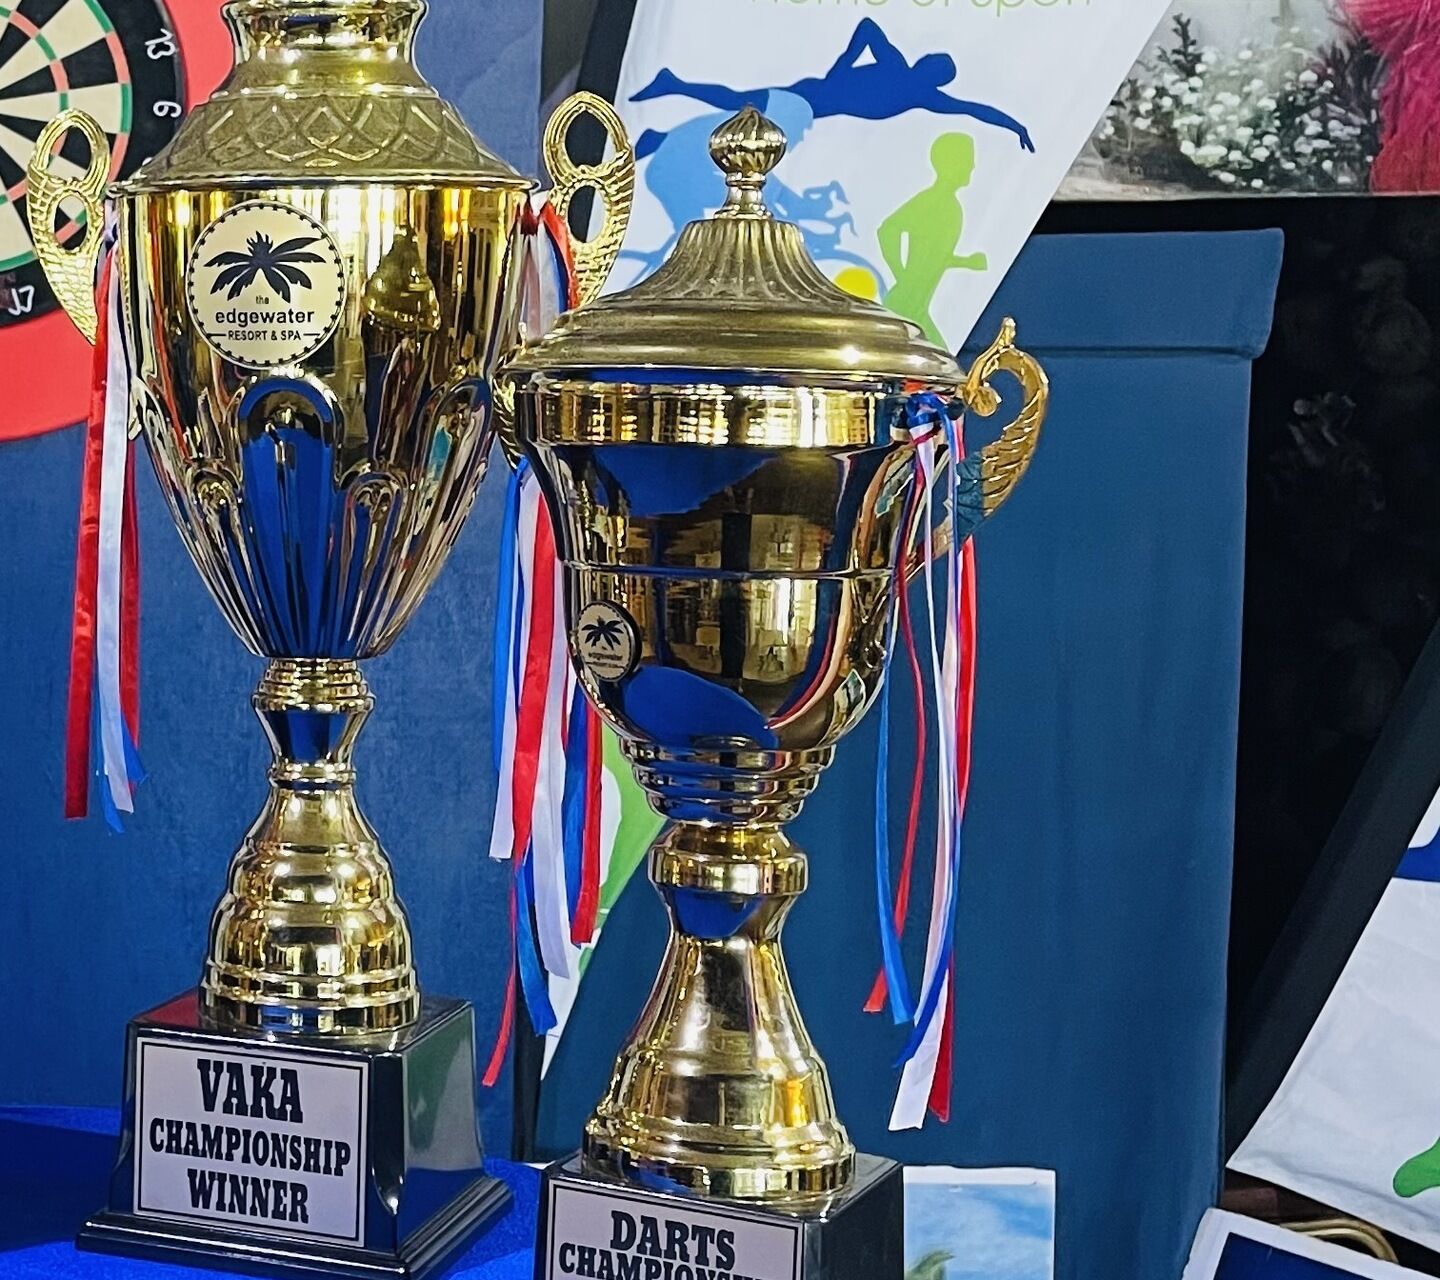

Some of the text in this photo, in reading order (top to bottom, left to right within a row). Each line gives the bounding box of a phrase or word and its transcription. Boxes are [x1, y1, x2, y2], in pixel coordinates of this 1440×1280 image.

[144, 28, 177, 60] 13
[215, 308, 314, 327] edgewater
[255, 295, 269, 305] the
[227, 330, 301, 341] RESORT & SPA
[196, 1058, 303, 1124] VAKA
[149, 1117, 351, 1177] CHAMPIONSHIP
[187, 1168, 309, 1223] WINNER
[610, 1210, 736, 1271] DARTS
